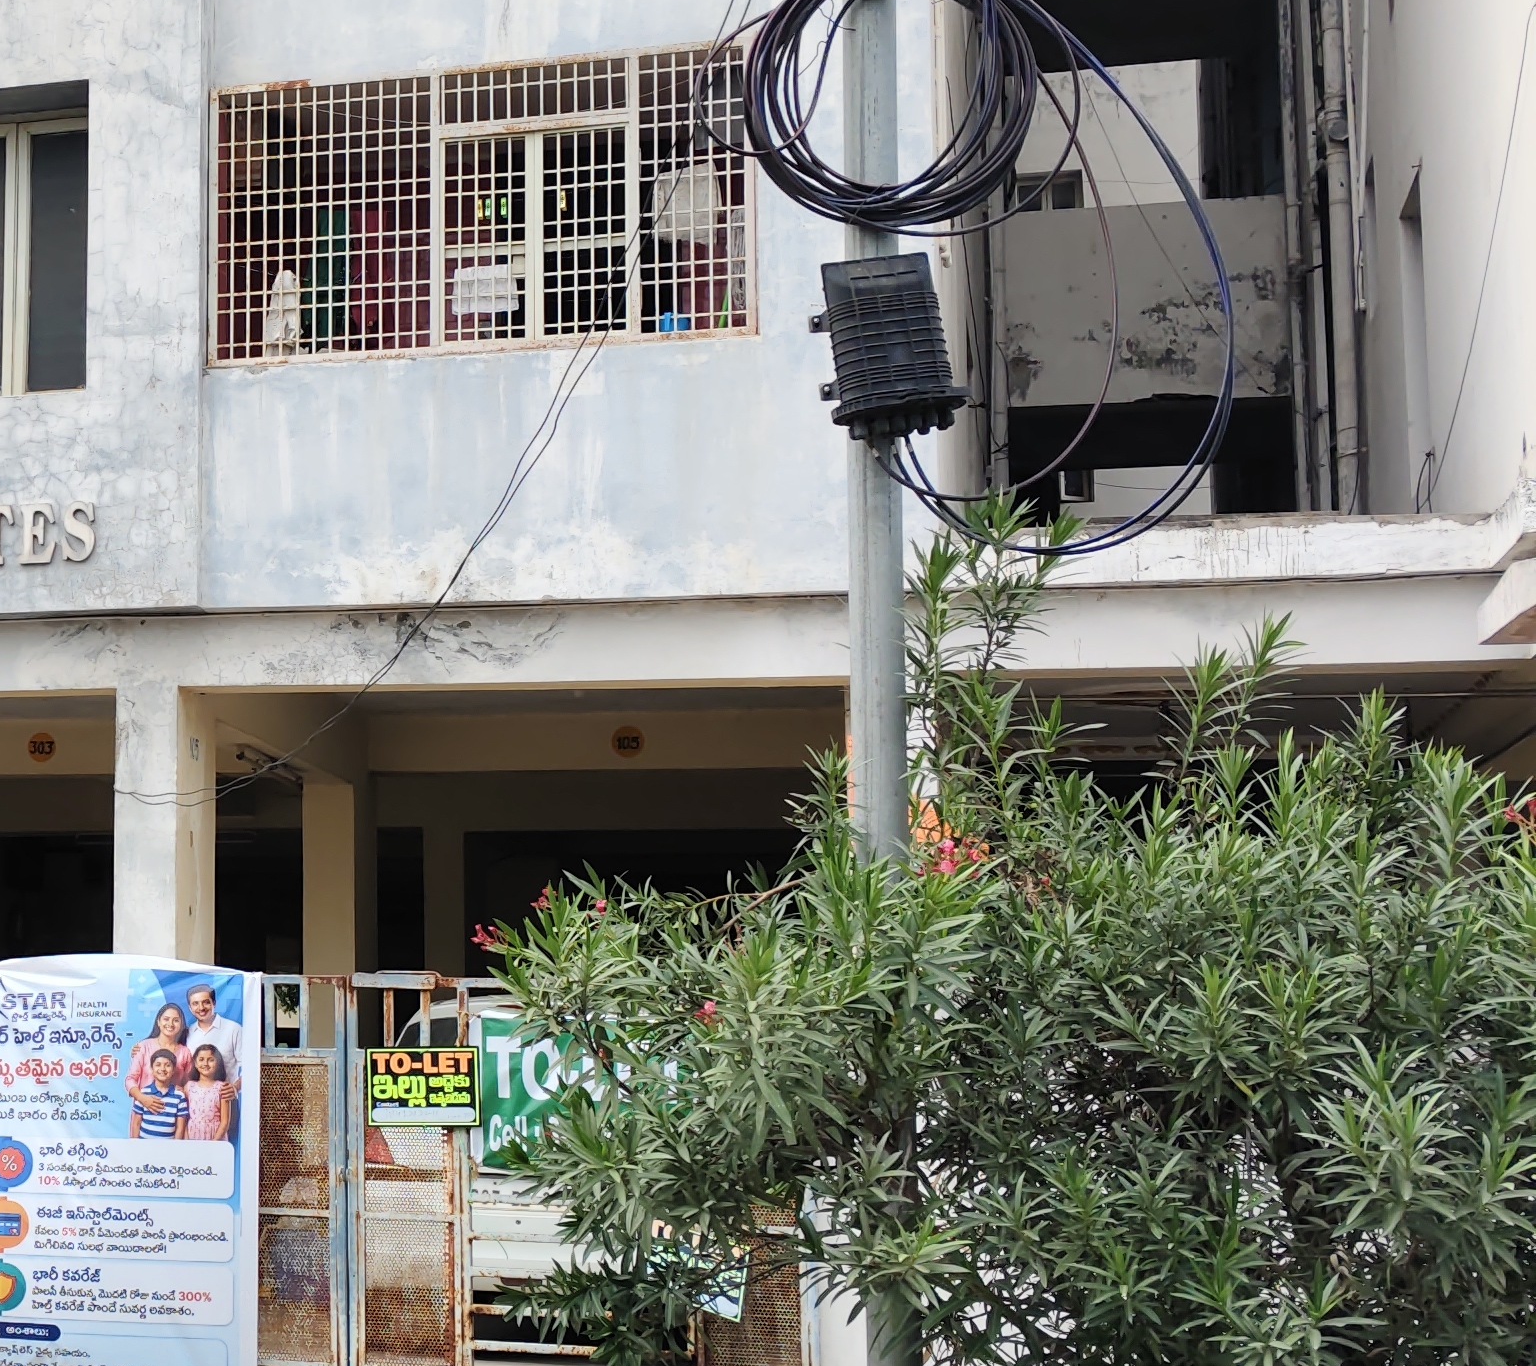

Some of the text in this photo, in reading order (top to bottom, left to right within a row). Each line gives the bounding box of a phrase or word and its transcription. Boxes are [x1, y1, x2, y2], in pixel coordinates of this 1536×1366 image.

[29, 740, 54, 755] 303
[1, 991, 108, 1010] STAR HEALTH
[76, 1010, 122, 1018] INSURANCE
[13, 1025, 47, 1051] హెల్త్
[49, 1023, 123, 1050] ఇన్సూరెన్స్
[372, 1052, 473, 1074] TO-LET
[372, 1074, 427, 1108] ఇల్లు
[38, 1175, 60, 1186] 10%
[178, 1291, 212, 1303] 300%
